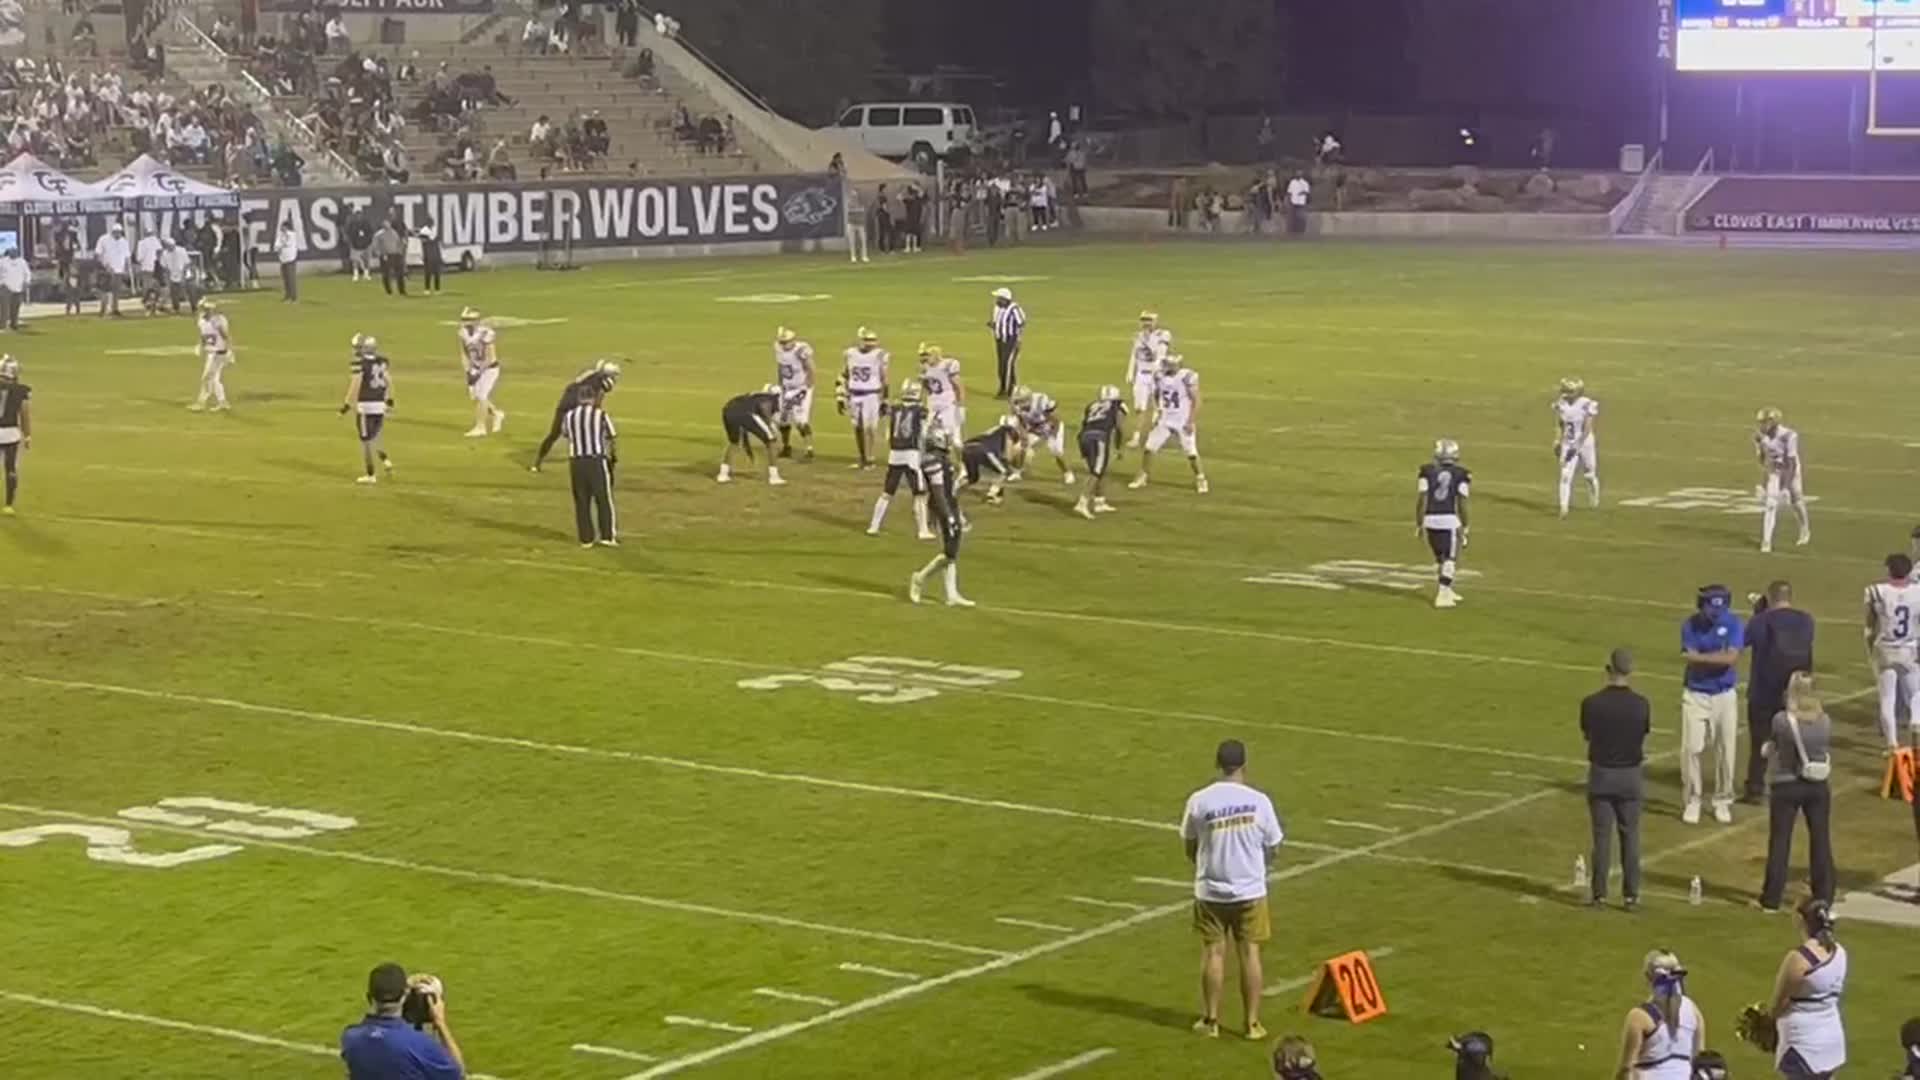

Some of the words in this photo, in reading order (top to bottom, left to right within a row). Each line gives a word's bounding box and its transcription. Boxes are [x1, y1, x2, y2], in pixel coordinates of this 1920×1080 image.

[1714, 213, 1763, 228] CLOVIS
[1767, 213, 1803, 229] EAST
[1162, 390, 1180, 408] 54
[893, 410, 914, 438] 14
[1893, 605, 1910, 638] 3
[0, 797, 358, 868] 20
[1338, 957, 1378, 1016] 20
